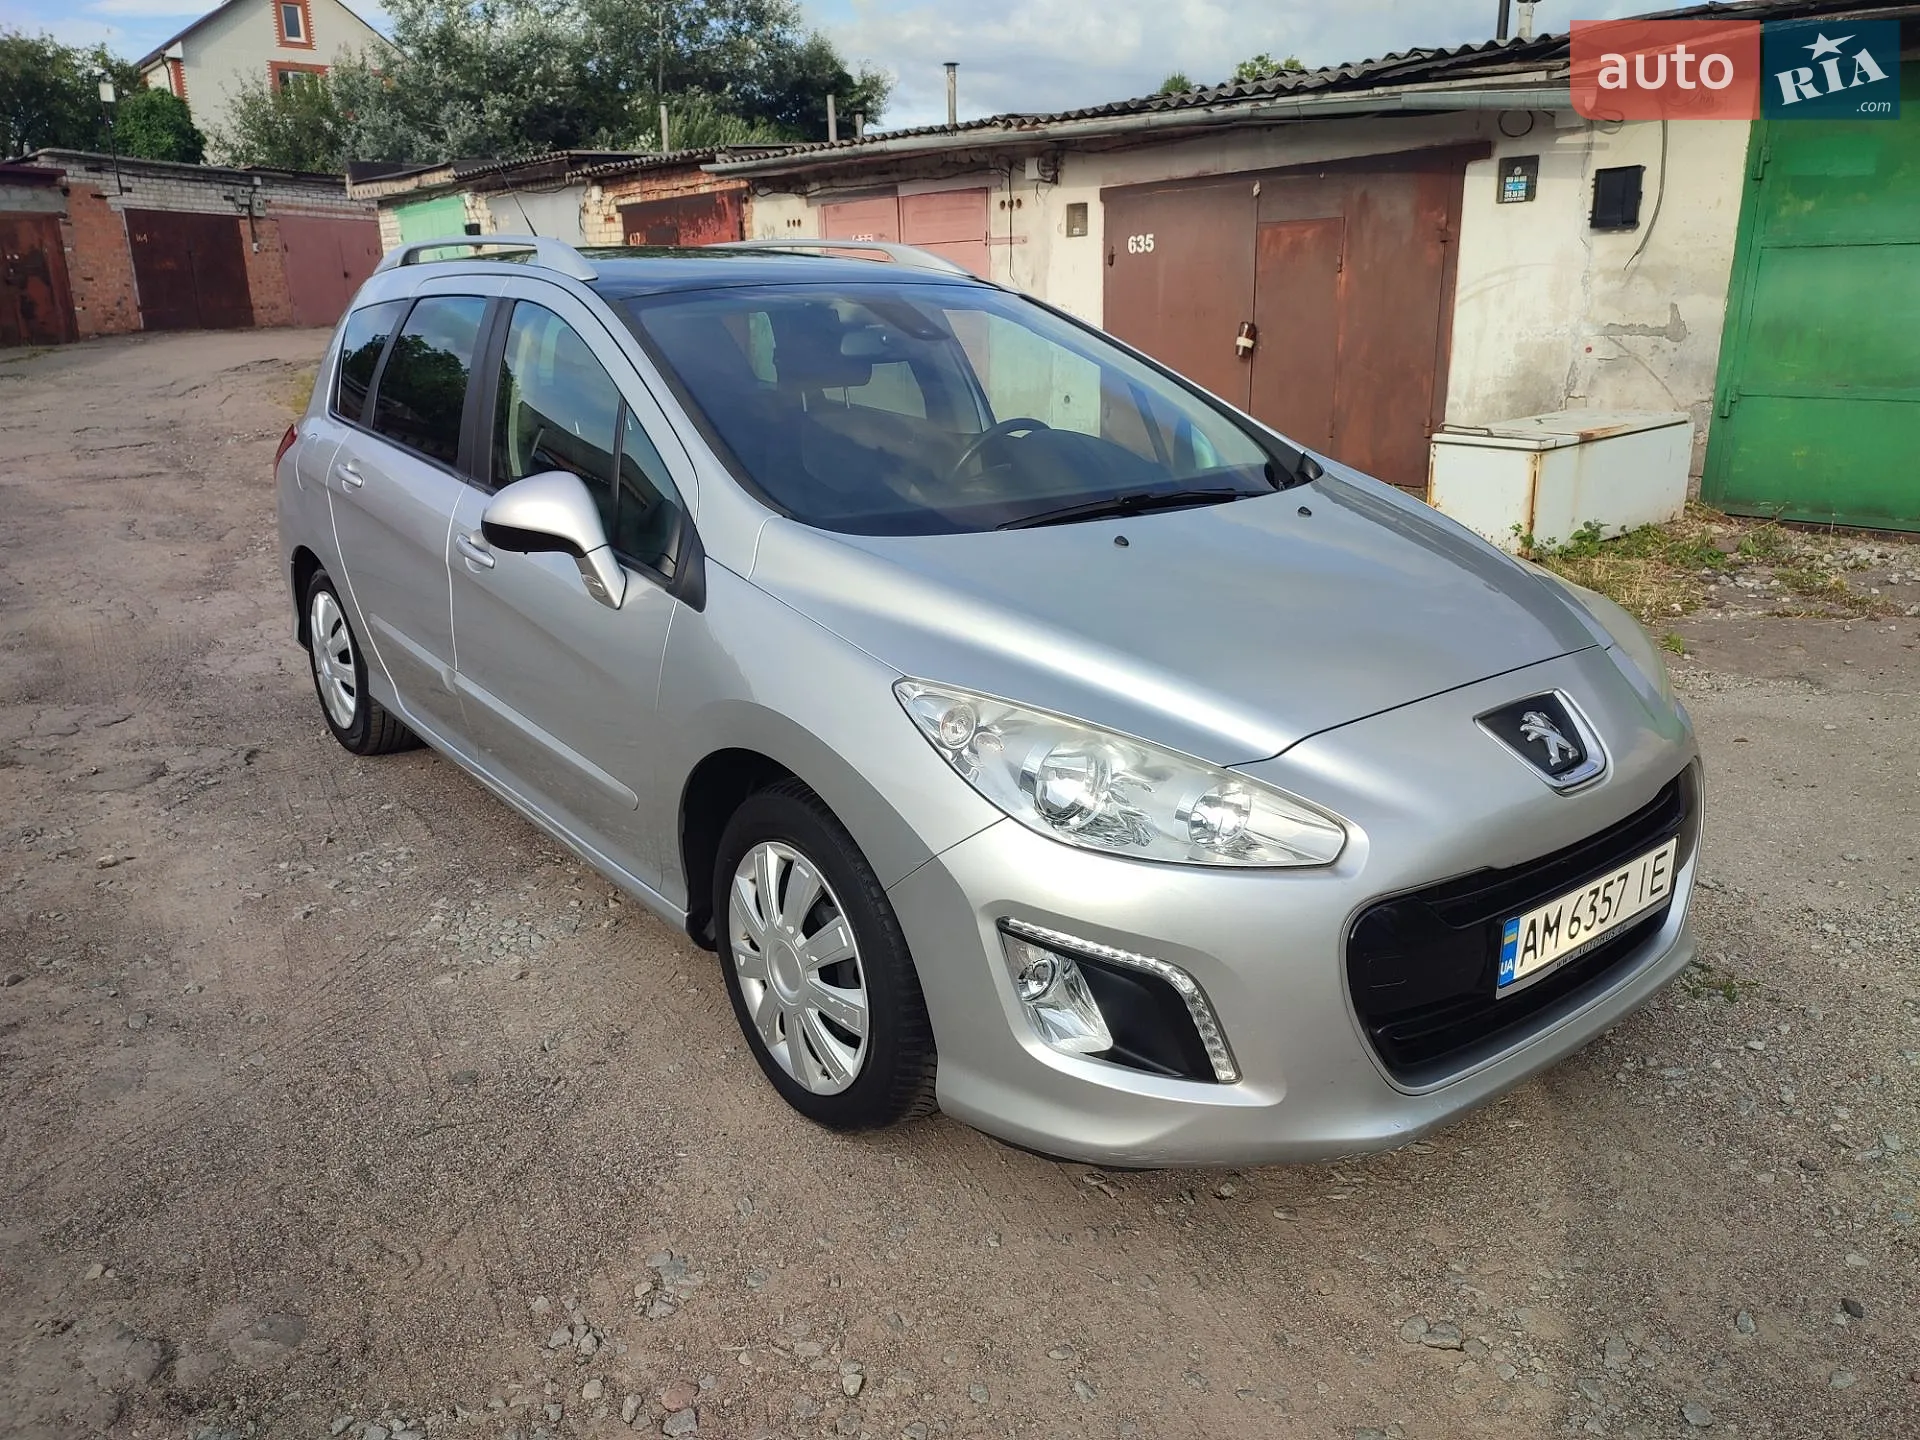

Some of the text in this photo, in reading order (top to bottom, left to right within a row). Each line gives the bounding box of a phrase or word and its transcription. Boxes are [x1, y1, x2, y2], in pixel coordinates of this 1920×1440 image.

[1127, 233, 1155, 254] 635
[1519, 904, 1563, 968] AM
[1567, 871, 1630, 940] 6357
[1638, 850, 1668, 904] IE
[1500, 957, 1514, 975] UA
